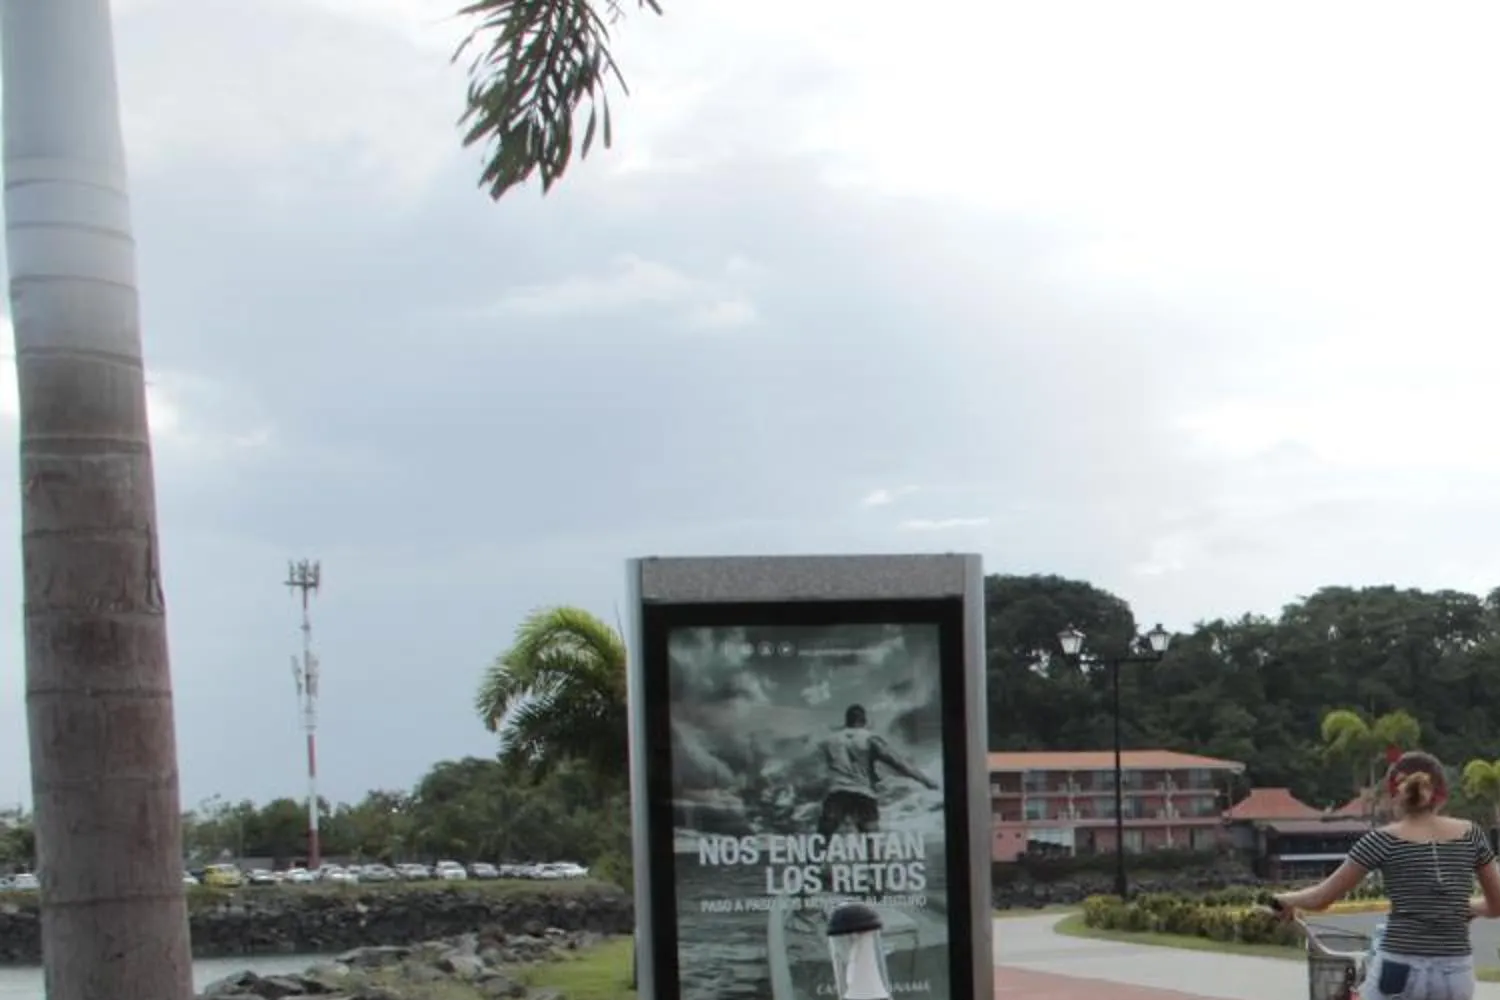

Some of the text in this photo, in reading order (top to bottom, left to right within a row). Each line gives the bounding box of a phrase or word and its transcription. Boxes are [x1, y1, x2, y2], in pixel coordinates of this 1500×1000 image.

[699, 832, 926, 866] NOS ENCANTAN
[765, 861, 927, 895] LOS RETOS
[700, 899, 732, 913] PASO
[733, 898, 744, 912] A
